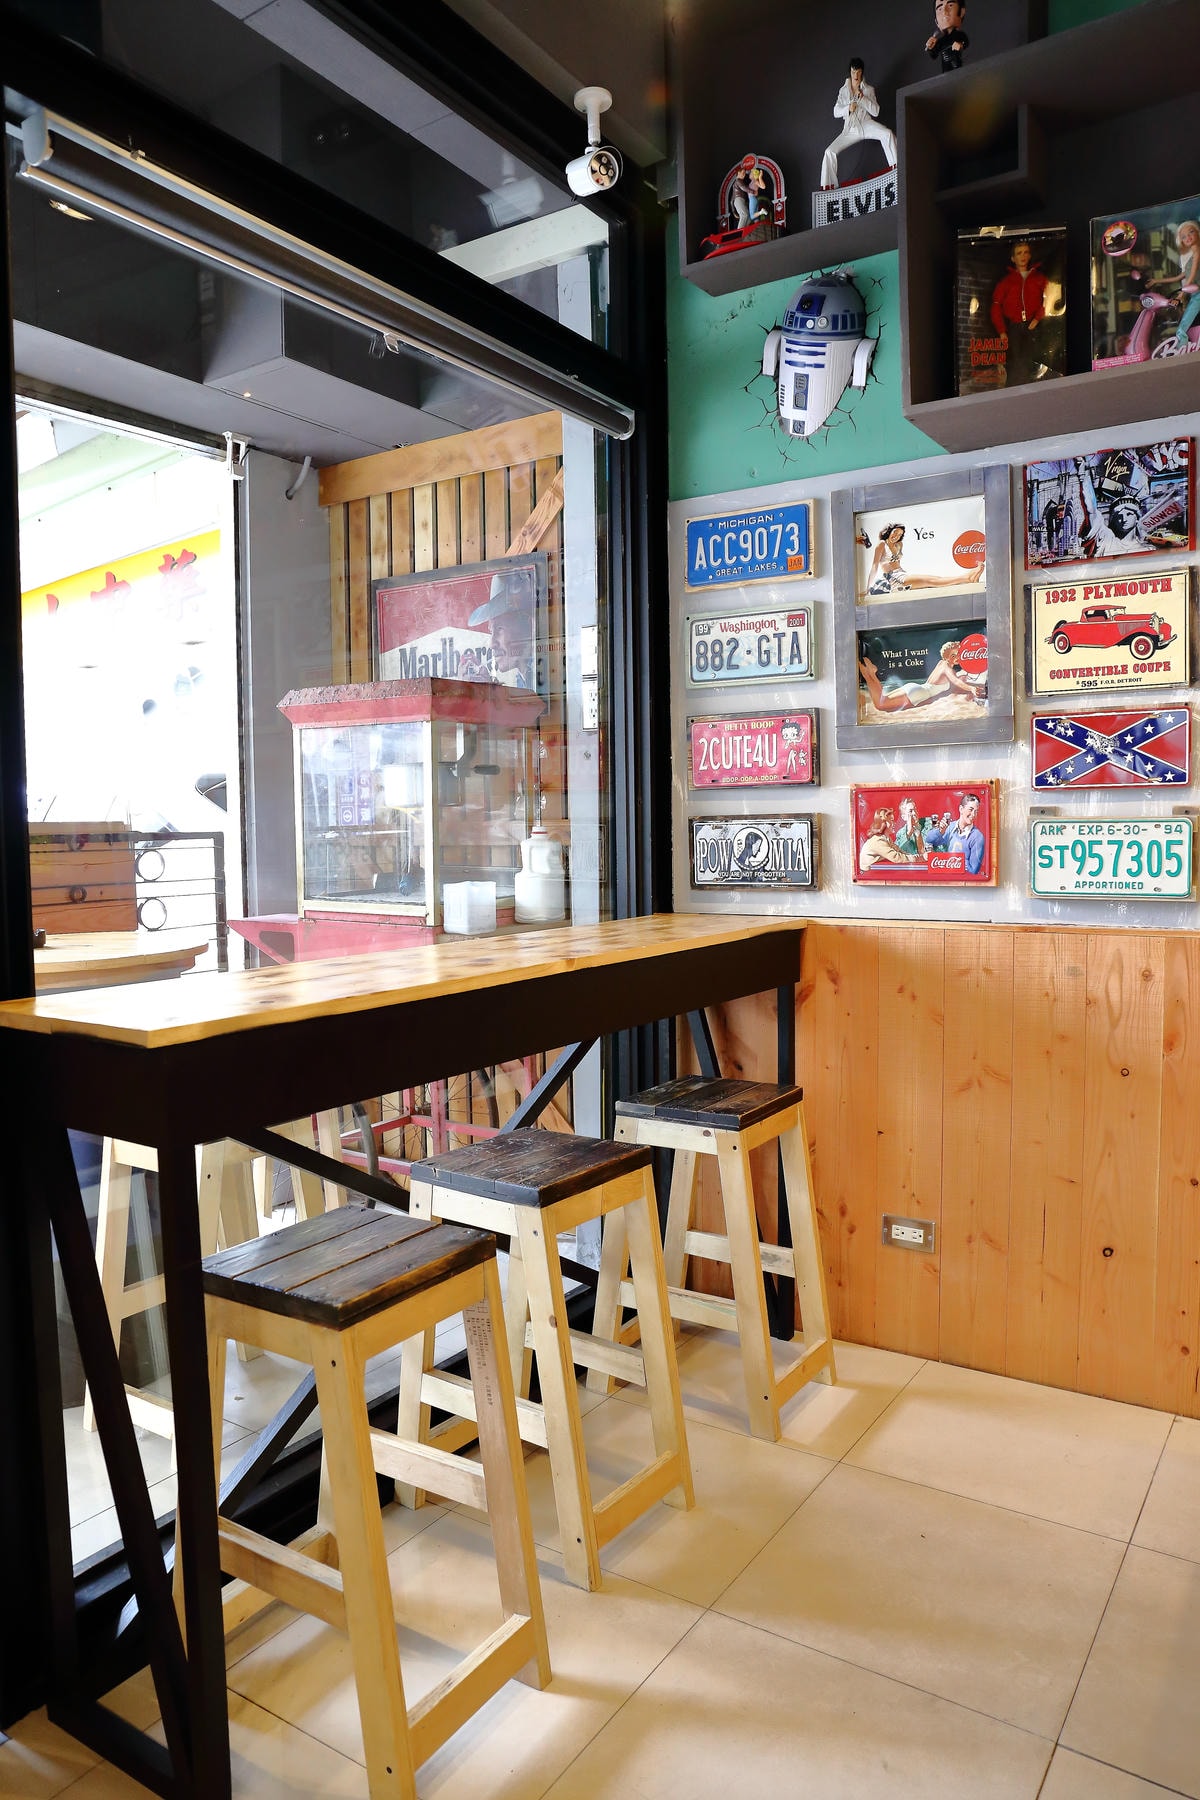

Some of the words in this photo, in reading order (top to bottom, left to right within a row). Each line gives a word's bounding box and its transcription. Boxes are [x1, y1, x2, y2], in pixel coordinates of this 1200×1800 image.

[826, 183, 896, 224] ELVIS
[968, 337, 1009, 352] JAMES
[971, 351, 1006, 366] DEAN
[1104, 451, 1130, 481] Virgin
[718, 514, 774, 530] MICHIGAN
[1142, 501, 1181, 529] Subway
[913, 527, 935, 541] Yes
[694, 522, 800, 572] ACC9073
[715, 566, 743, 577] GREAT
[748, 562, 778, 573] LAKES
[789, 559, 802, 569] JAN
[1045, 588, 1077, 605] 1932
[1083, 578, 1173, 601] PLYMOUTH
[719, 619, 779, 634] Washington
[790, 618, 803, 626] 2001
[882, 650, 901, 659] What
[905, 650, 909, 658] I
[910, 649, 929, 657] want
[889, 660, 896, 668] is
[905, 658, 924, 667] Coke
[1049, 664, 1128, 680] CONVERTIBLE
[1133, 661, 1171, 674] COUPE
[751, 720, 774, 730] BOOP
[699, 733, 777, 770] 2CUTE4U
[1040, 826, 1064, 836] ARK
[699, 838, 732, 871] POW
[770, 838, 806, 871] MIA
[1074, 880, 1144, 890] APPORTIONED
